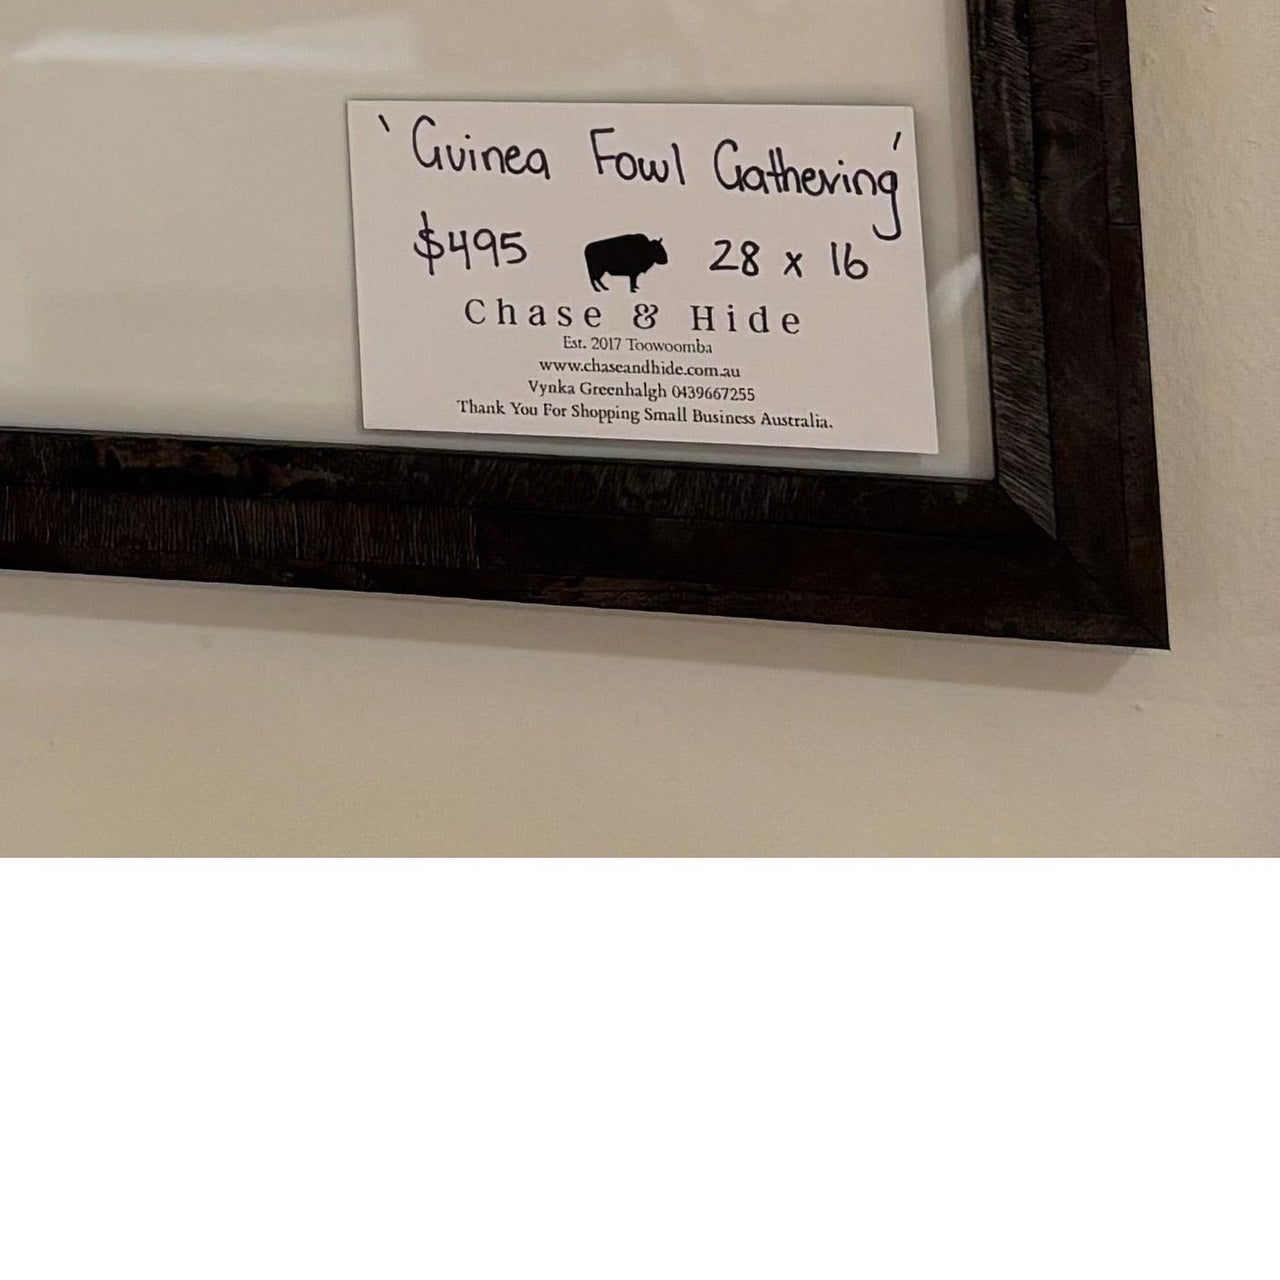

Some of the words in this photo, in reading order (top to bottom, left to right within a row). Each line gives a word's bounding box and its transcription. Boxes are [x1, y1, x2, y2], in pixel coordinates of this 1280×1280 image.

[589, 127, 686, 186] Fowl
[713, 132, 902, 241] Gathering'
[412, 210, 528, 276] $495
[709, 239, 760, 277] 28
[783, 251, 803, 278] x
[830, 241, 869, 280] 16
[464, 298, 602, 328] Chase
[632, 303, 659, 330] &
[689, 304, 801, 335] Hide
[563, 335, 588, 350] Est.
[591, 337, 622, 351] 2017
[625, 338, 713, 354] Toowoomba
[539, 357, 741, 378] www.chaseandhide.com.au
[528, 379, 576, 397] Vynka
[579, 381, 667, 402] Greenhalgh
[672, 385, 756, 402] 0439667255
[456, 398, 507, 416] Thank
[509, 401, 538, 417] You
[543, 402, 568, 418] For
[571, 403, 641, 425] Shopping
[644, 406, 688, 423] Small
[692, 408, 757, 425] Business
[760, 411, 834, 429] Australia.
